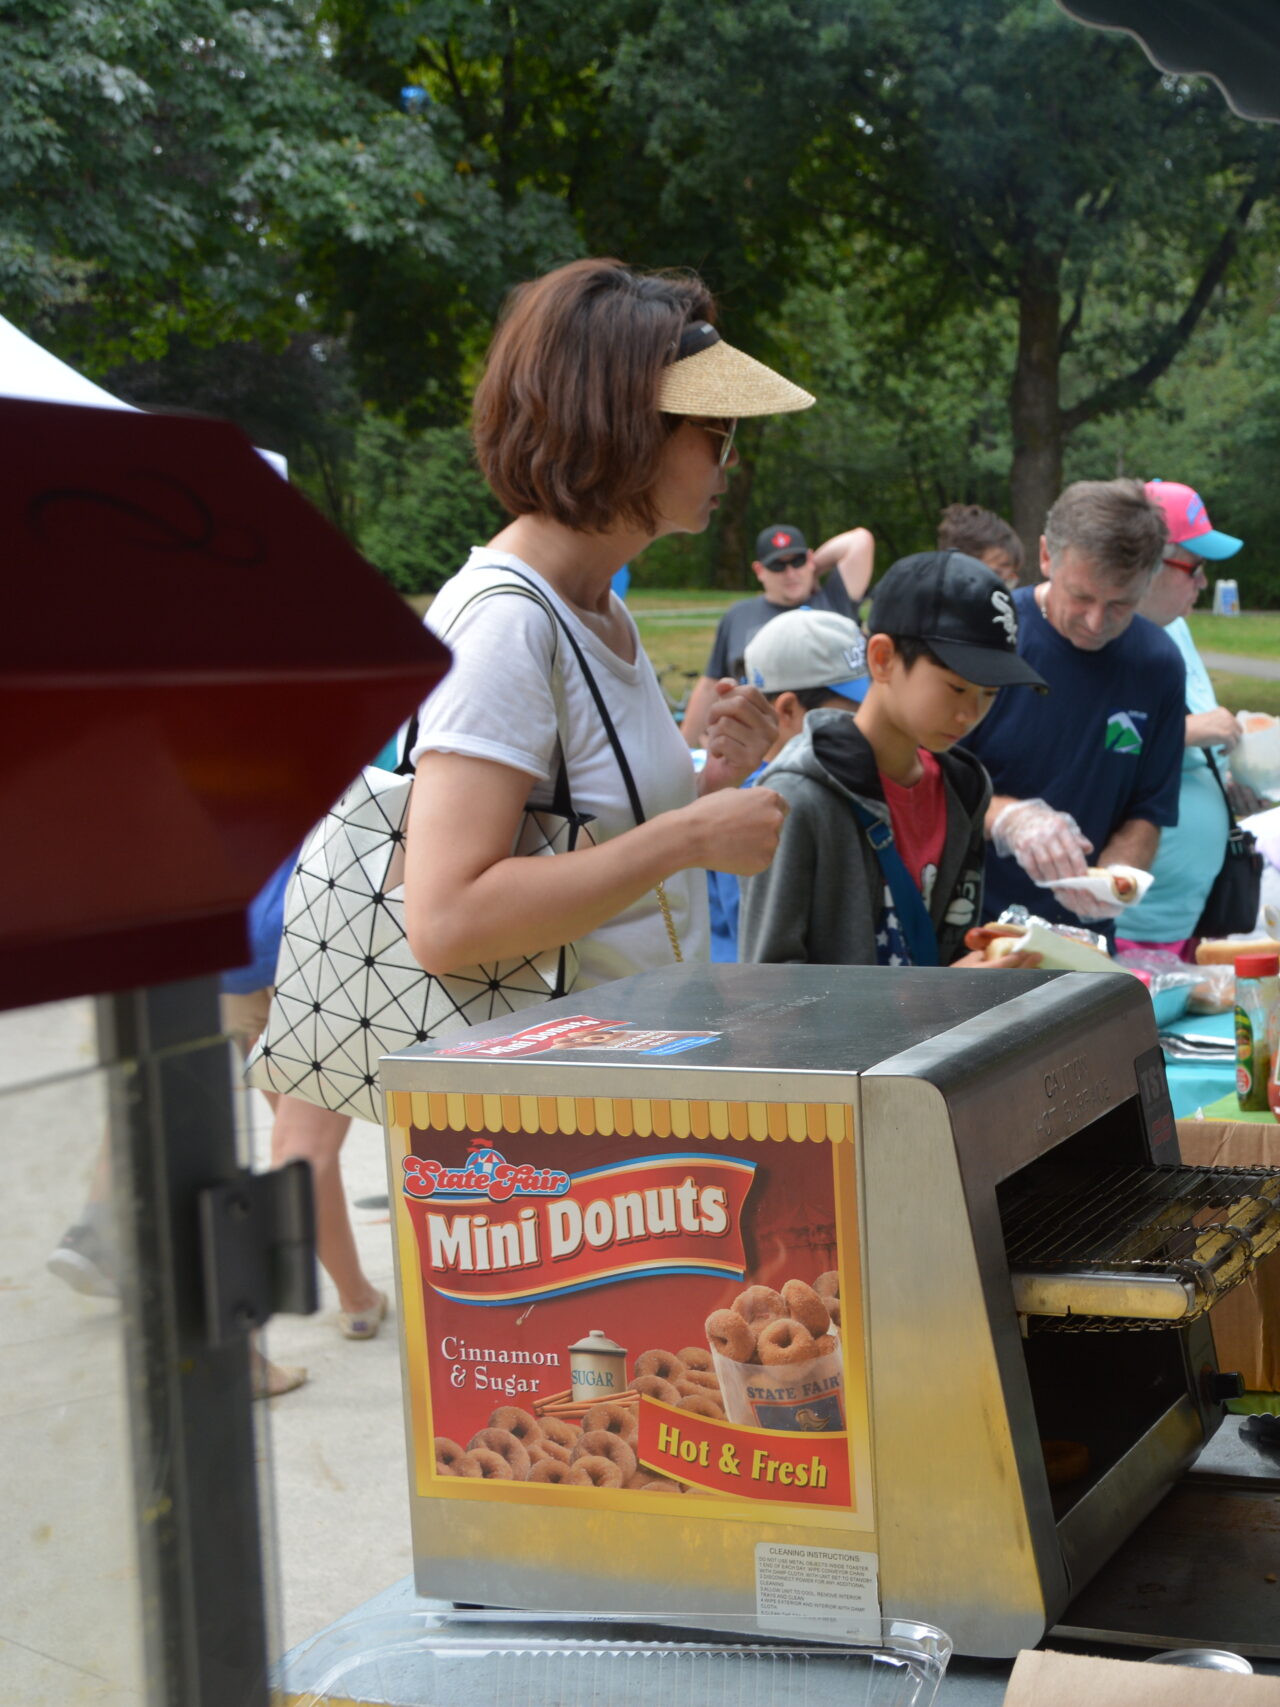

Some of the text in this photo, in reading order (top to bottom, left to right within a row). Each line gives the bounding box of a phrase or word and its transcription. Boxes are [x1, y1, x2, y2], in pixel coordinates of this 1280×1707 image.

[529, 1018, 601, 1044] Donuts
[403, 1155, 568, 1201] State Fair
[425, 1176, 728, 1272] Mini Donuts
[441, 1335, 561, 1367] Cinnamon
[450, 1365, 541, 1397] & Sugar
[571, 1368, 615, 1388] SUGAR
[746, 1375, 840, 1400] STATE FAIR
[658, 1423, 828, 1488] Hot & Fresh
[769, 1547, 861, 1562] CLEANING INSTRUCTIONS
